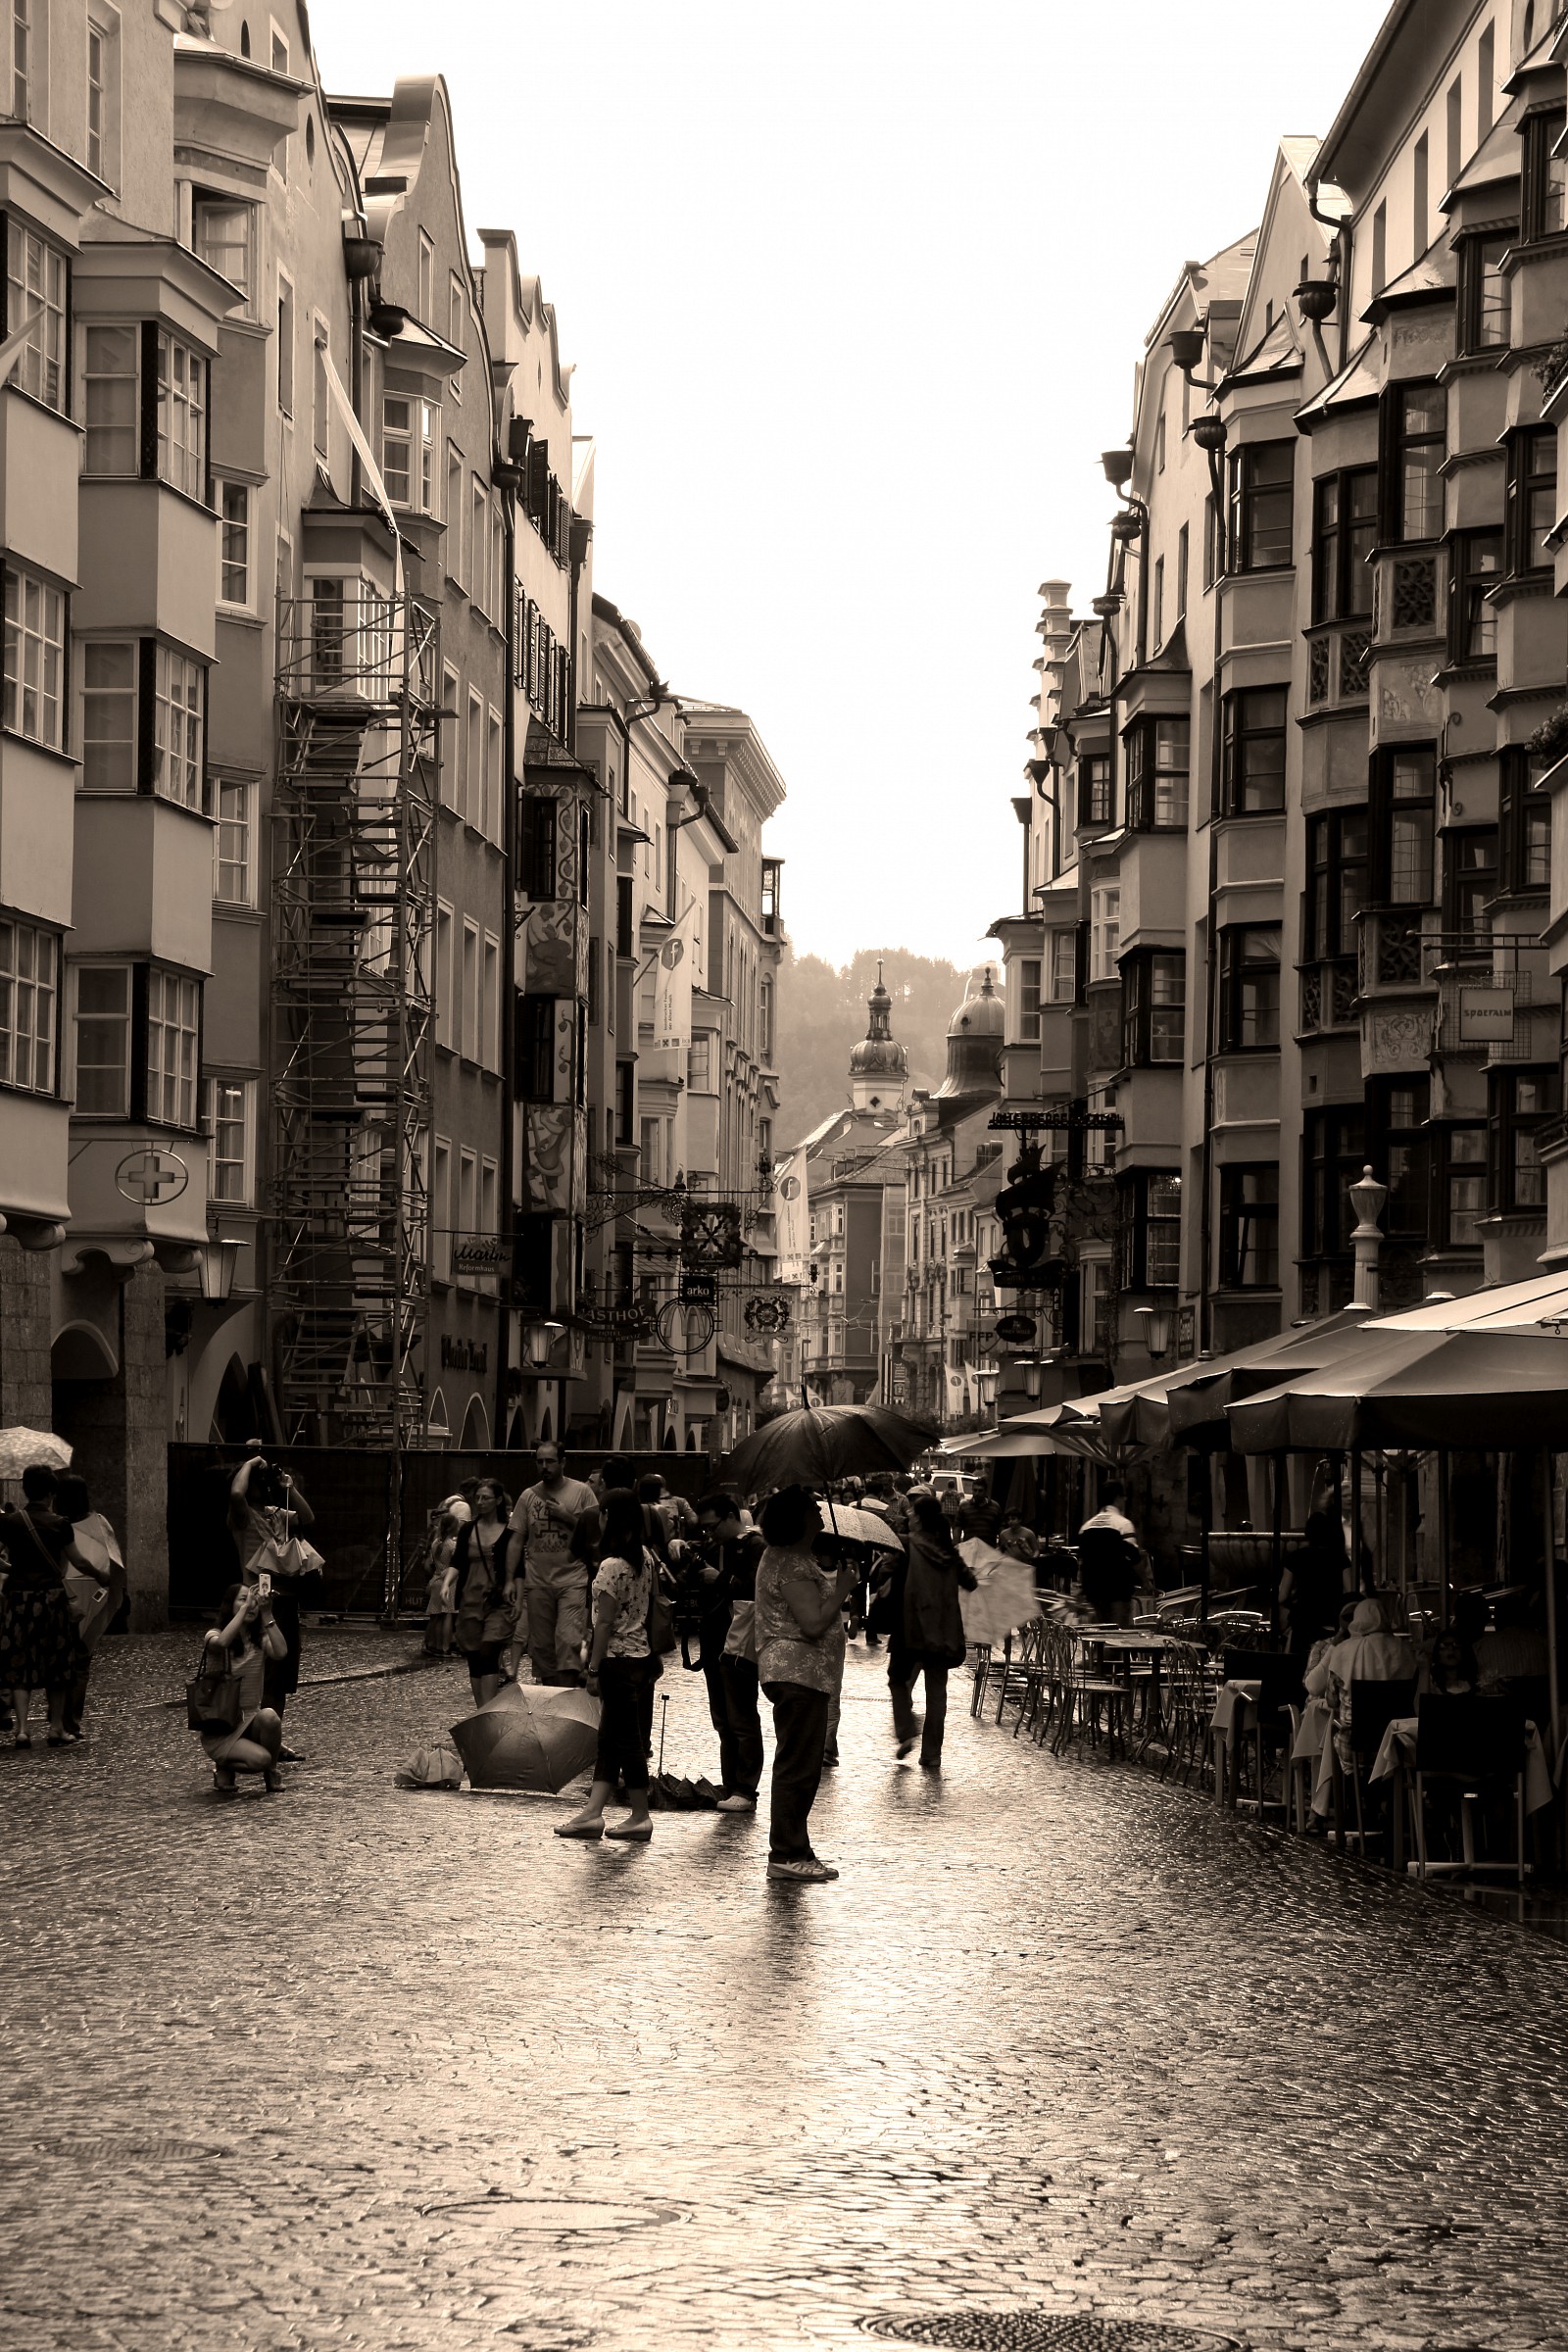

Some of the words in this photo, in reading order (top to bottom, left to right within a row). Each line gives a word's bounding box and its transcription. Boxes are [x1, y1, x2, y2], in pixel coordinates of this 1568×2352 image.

[454, 1245, 512, 1261] Martin
[459, 1263, 495, 1273] Reformhaus
[686, 1285, 710, 1296] arko
[583, 1303, 646, 1322] ASTHOF
